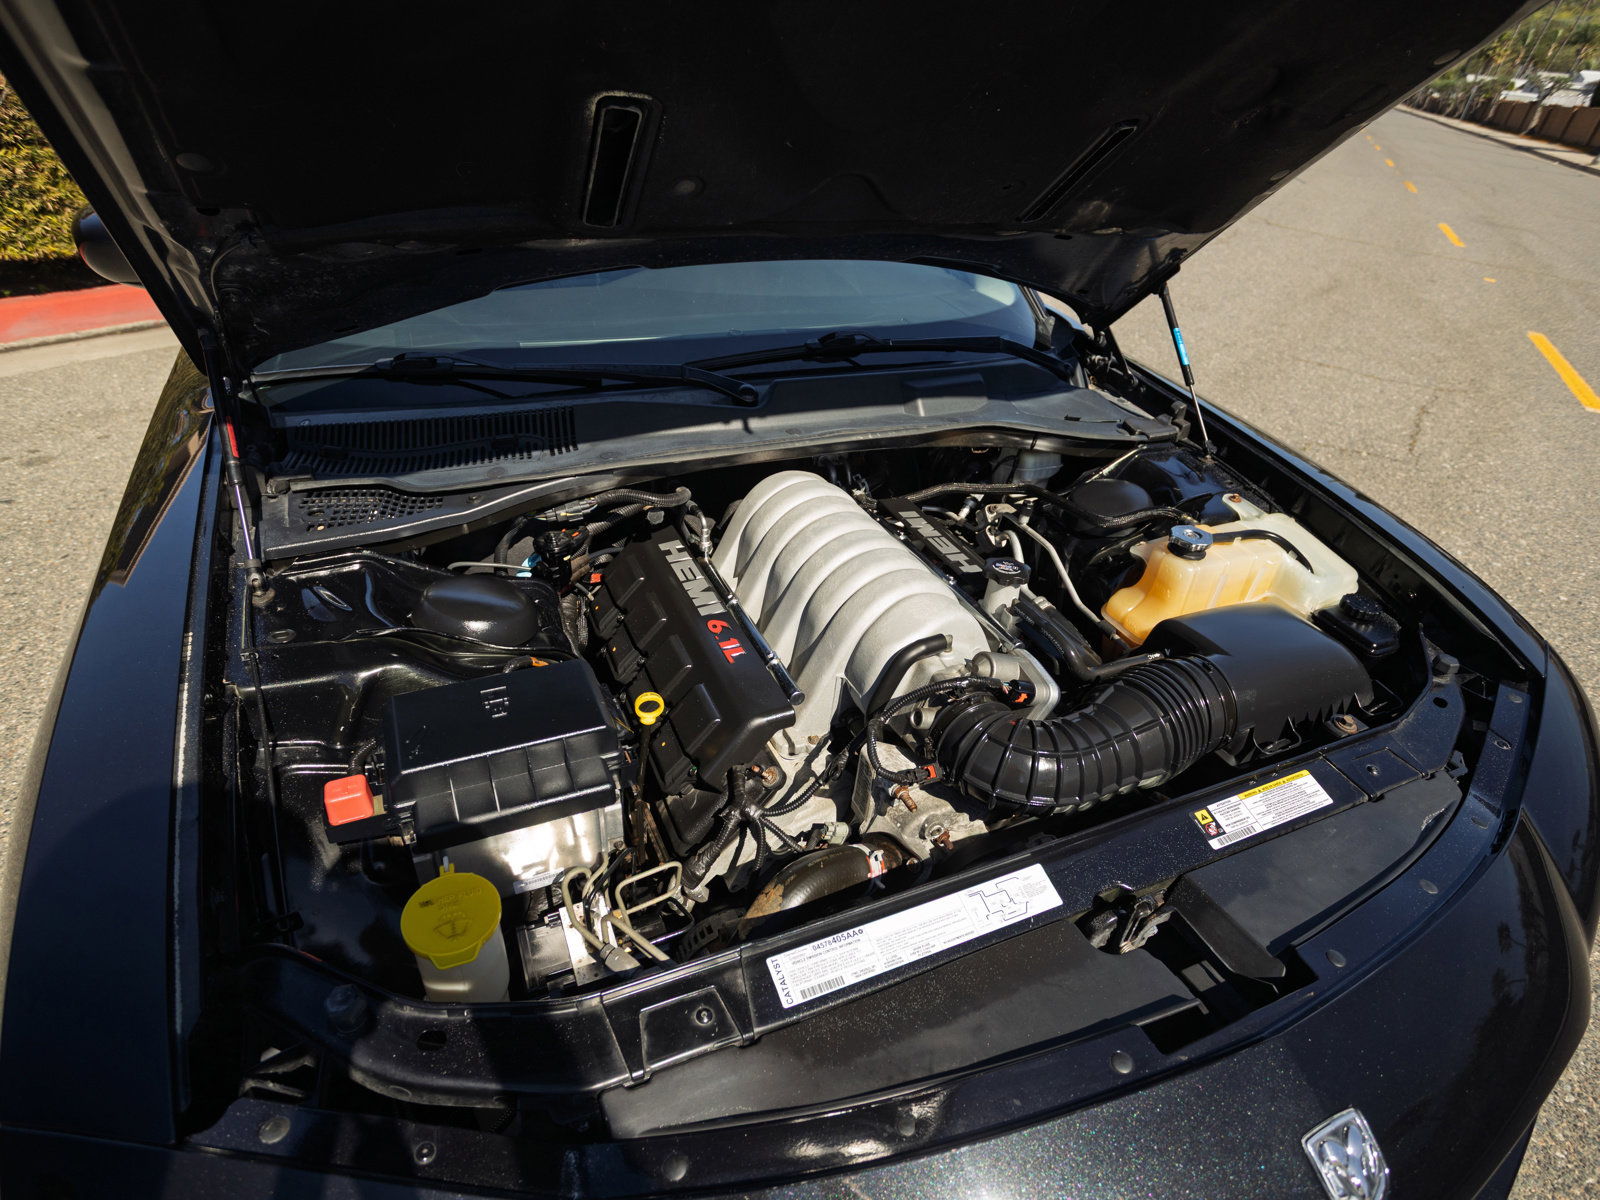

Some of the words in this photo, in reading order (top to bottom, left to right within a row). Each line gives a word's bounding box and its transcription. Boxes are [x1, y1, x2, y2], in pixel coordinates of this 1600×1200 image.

[898, 510, 983, 573] HEMI
[658, 539, 728, 617] HEMI
[706, 619, 747, 664] 6.1L
[812, 930, 858, 951] 04578405AA
[771, 958, 794, 1004] CATALYST
